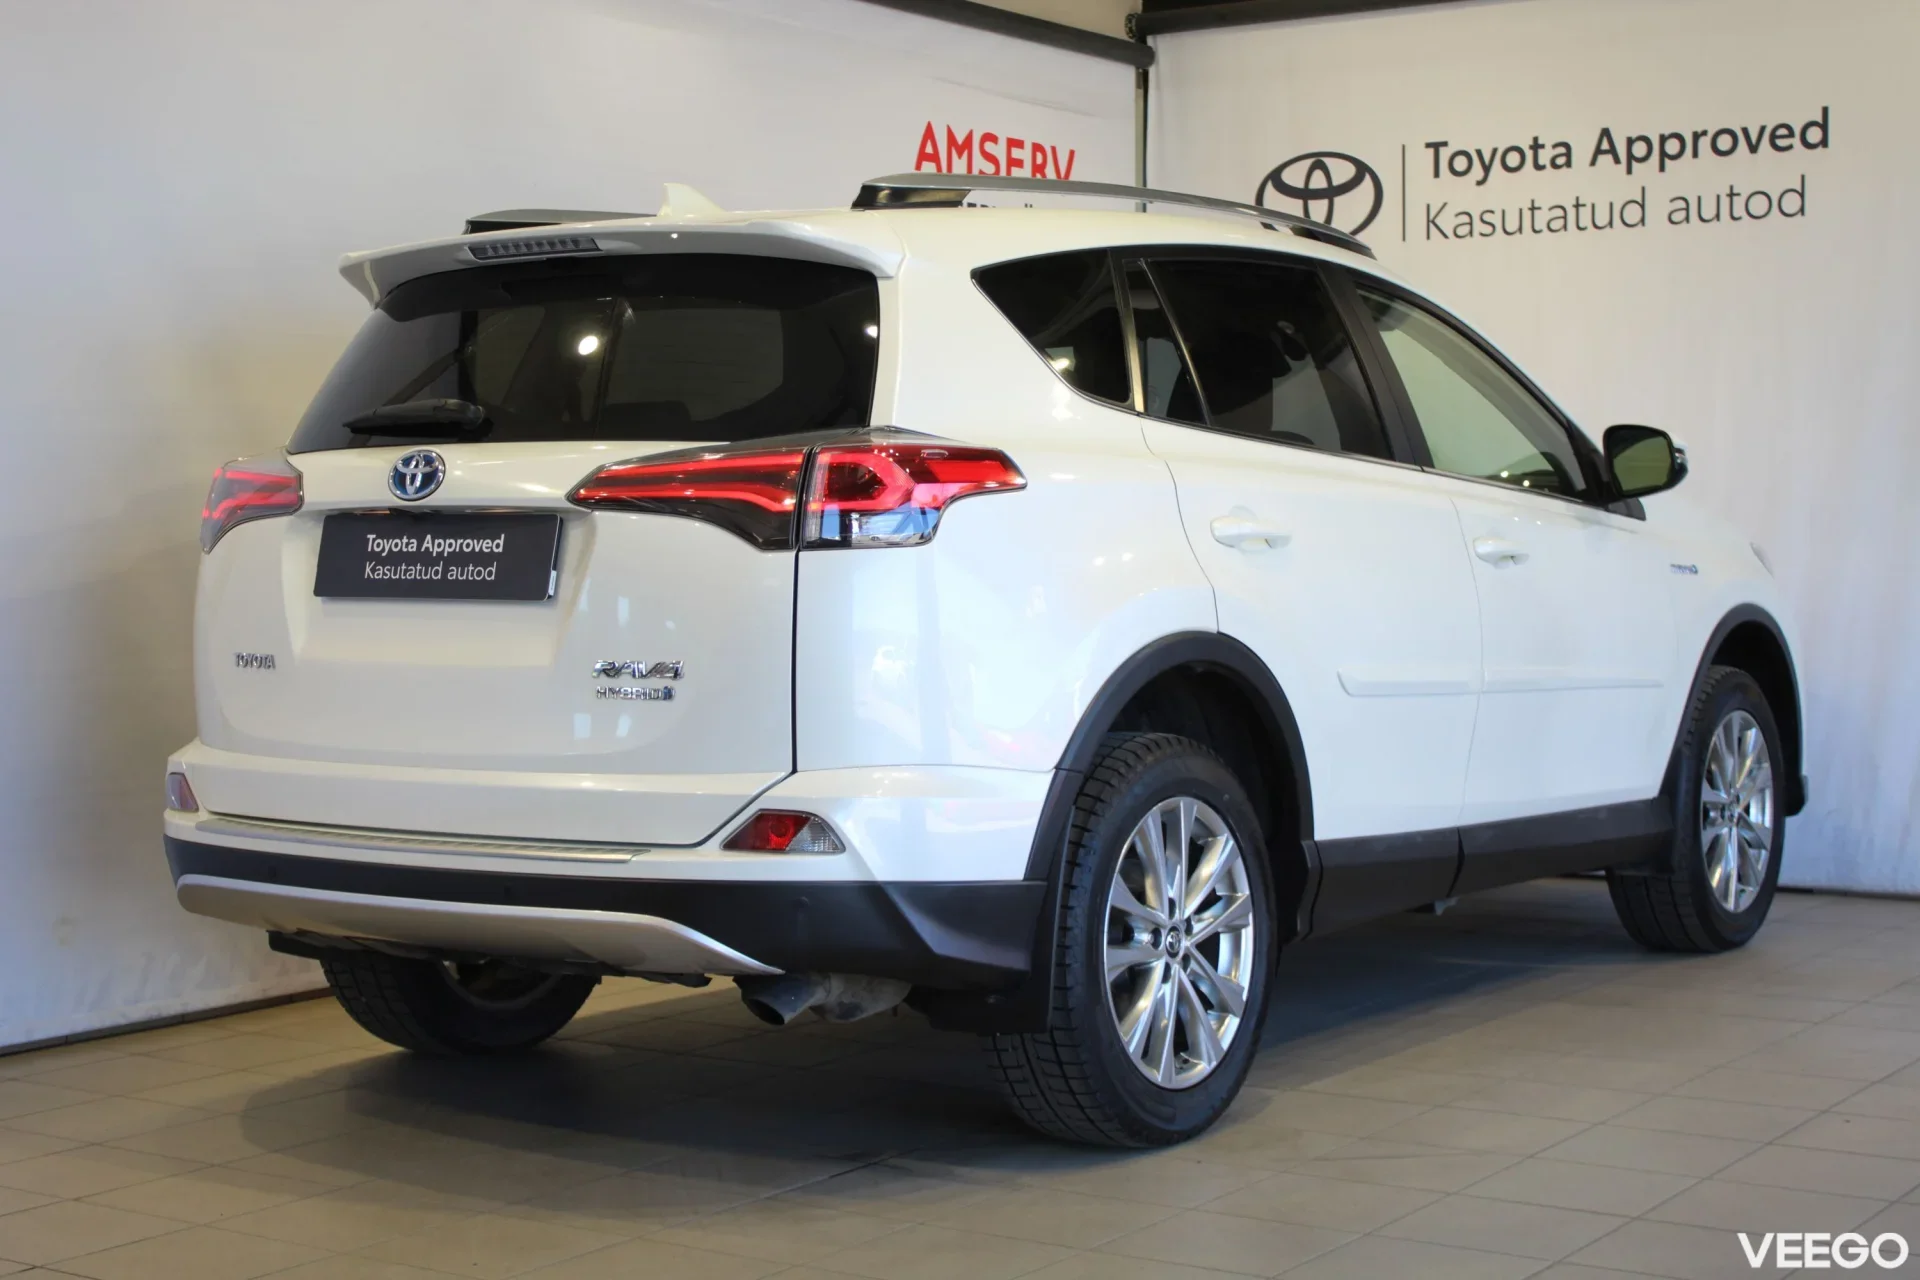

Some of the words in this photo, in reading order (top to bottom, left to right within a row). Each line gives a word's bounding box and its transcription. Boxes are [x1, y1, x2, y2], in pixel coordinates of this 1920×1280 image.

[915, 121, 1076, 181] AMSERV
[1425, 136, 1573, 186] Toyota
[1589, 106, 1830, 175] Approved
[1426, 186, 1646, 240] Kasutatud
[1667, 174, 1806, 226] autod
[366, 534, 418, 556] Toyota
[421, 534, 505, 556] Approved
[364, 561, 443, 580] Kasutatud
[447, 561, 497, 580] autod
[235, 652, 276, 670] TOYOTA
[592, 660, 684, 680] RAV4
[596, 686, 662, 700] HYBRID
